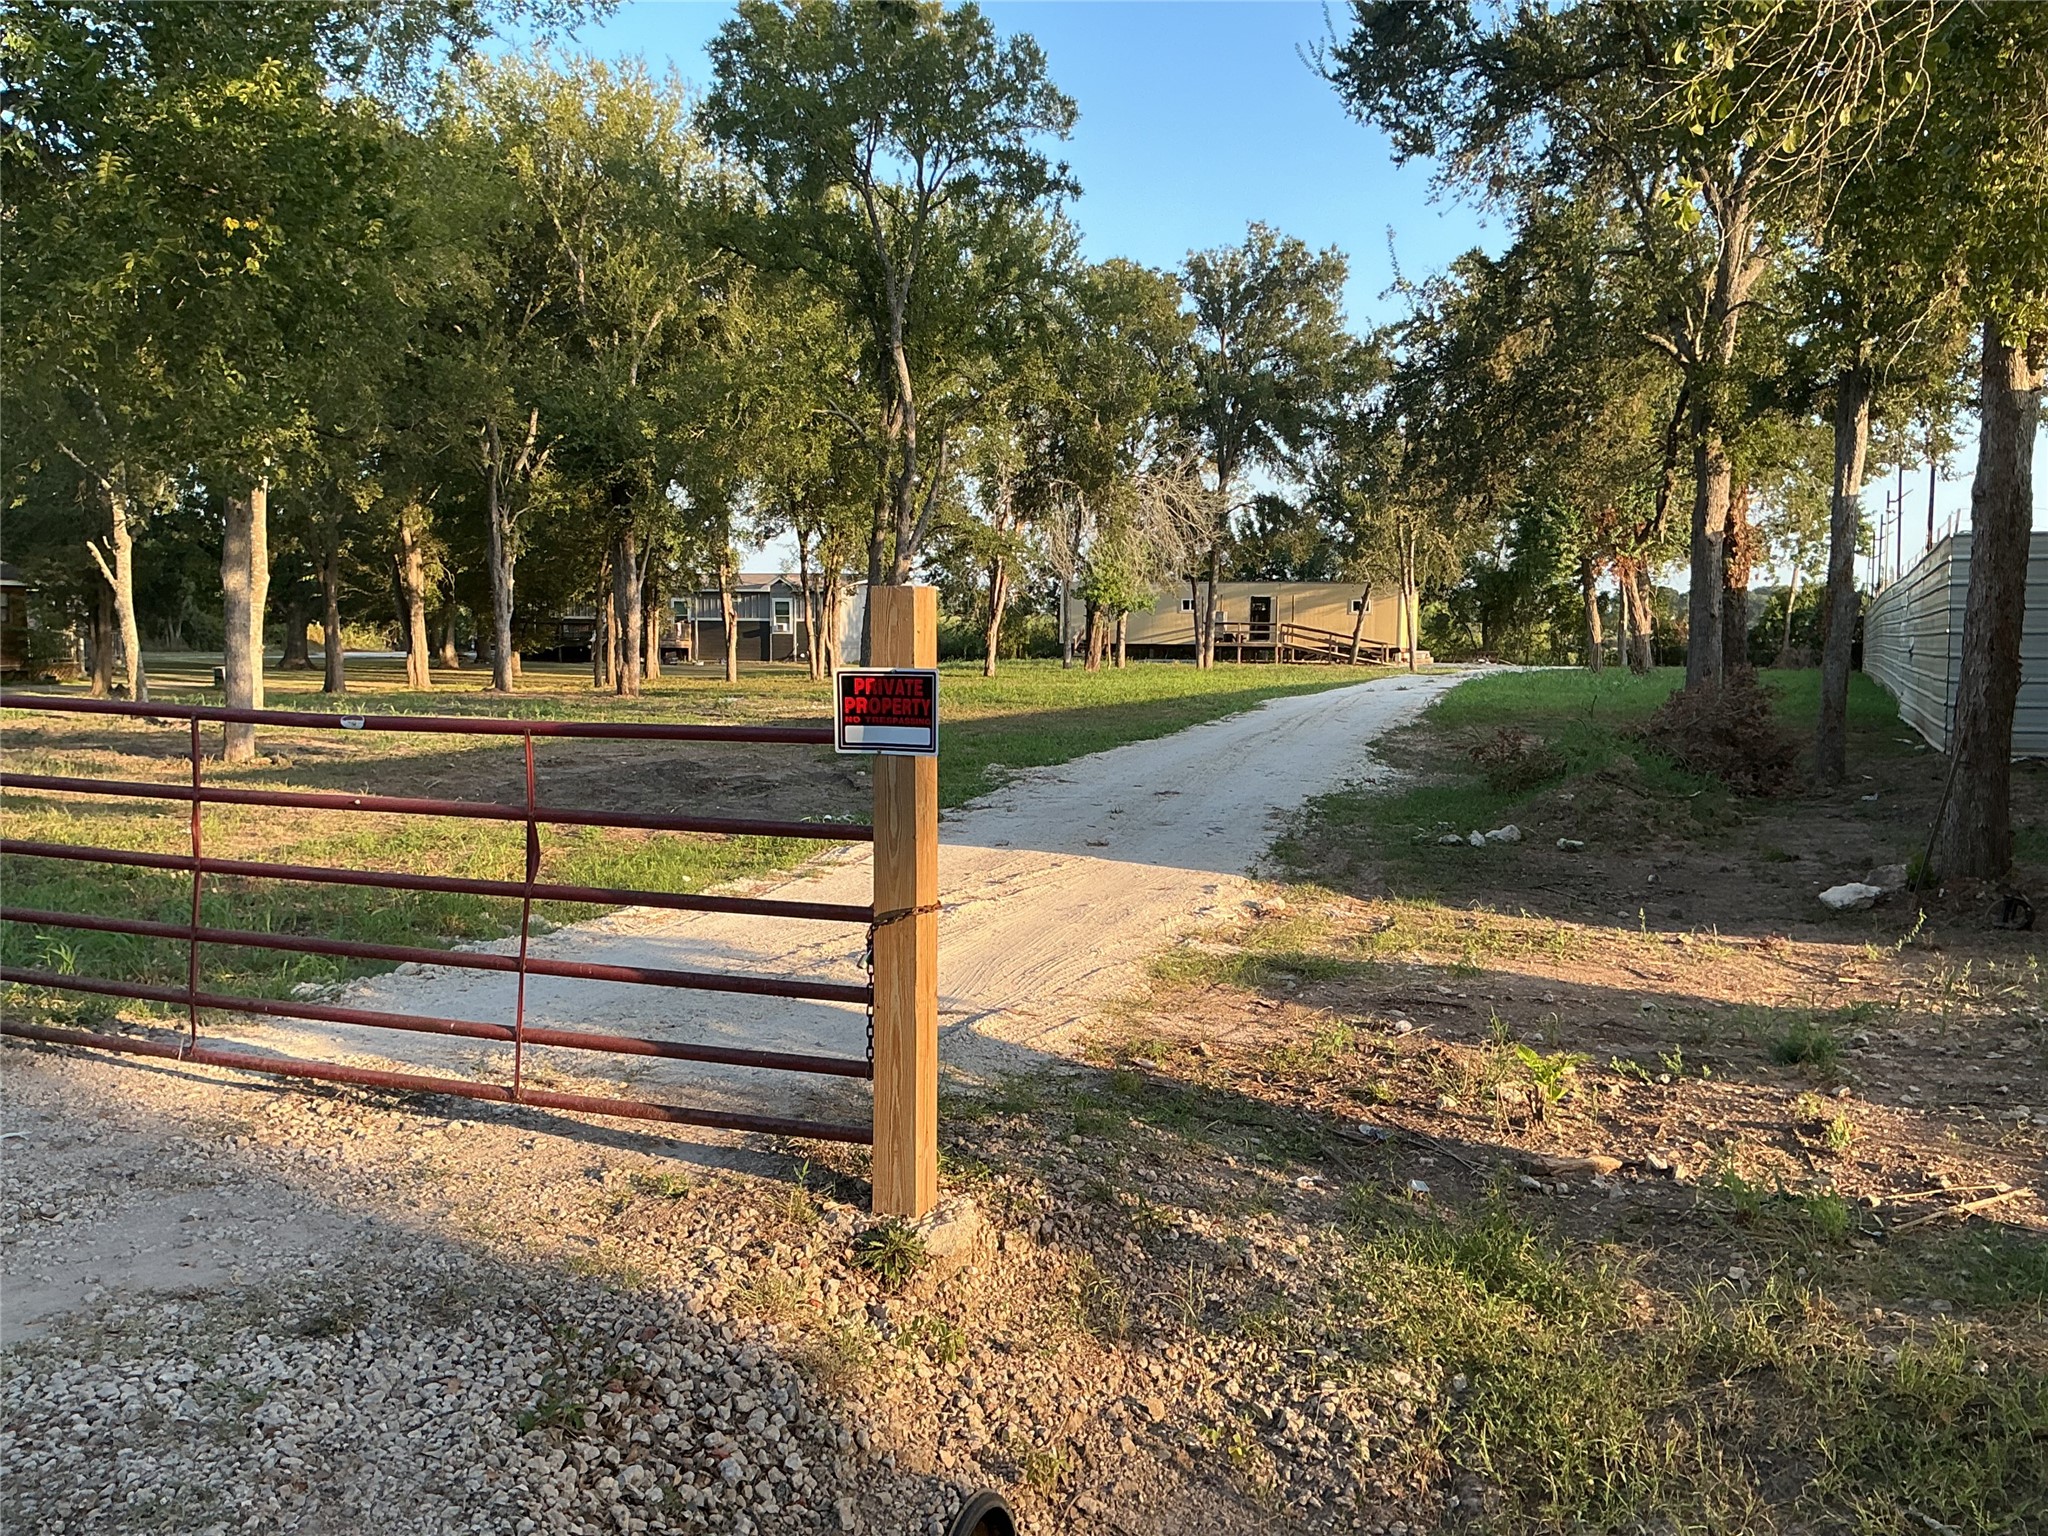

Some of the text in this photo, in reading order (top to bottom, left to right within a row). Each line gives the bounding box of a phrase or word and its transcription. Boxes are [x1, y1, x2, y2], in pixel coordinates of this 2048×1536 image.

[854, 677, 924, 696] PRIVATE
[844, 696, 931, 716] PROPERTY
[865, 716, 931, 725] TRESPASSING
